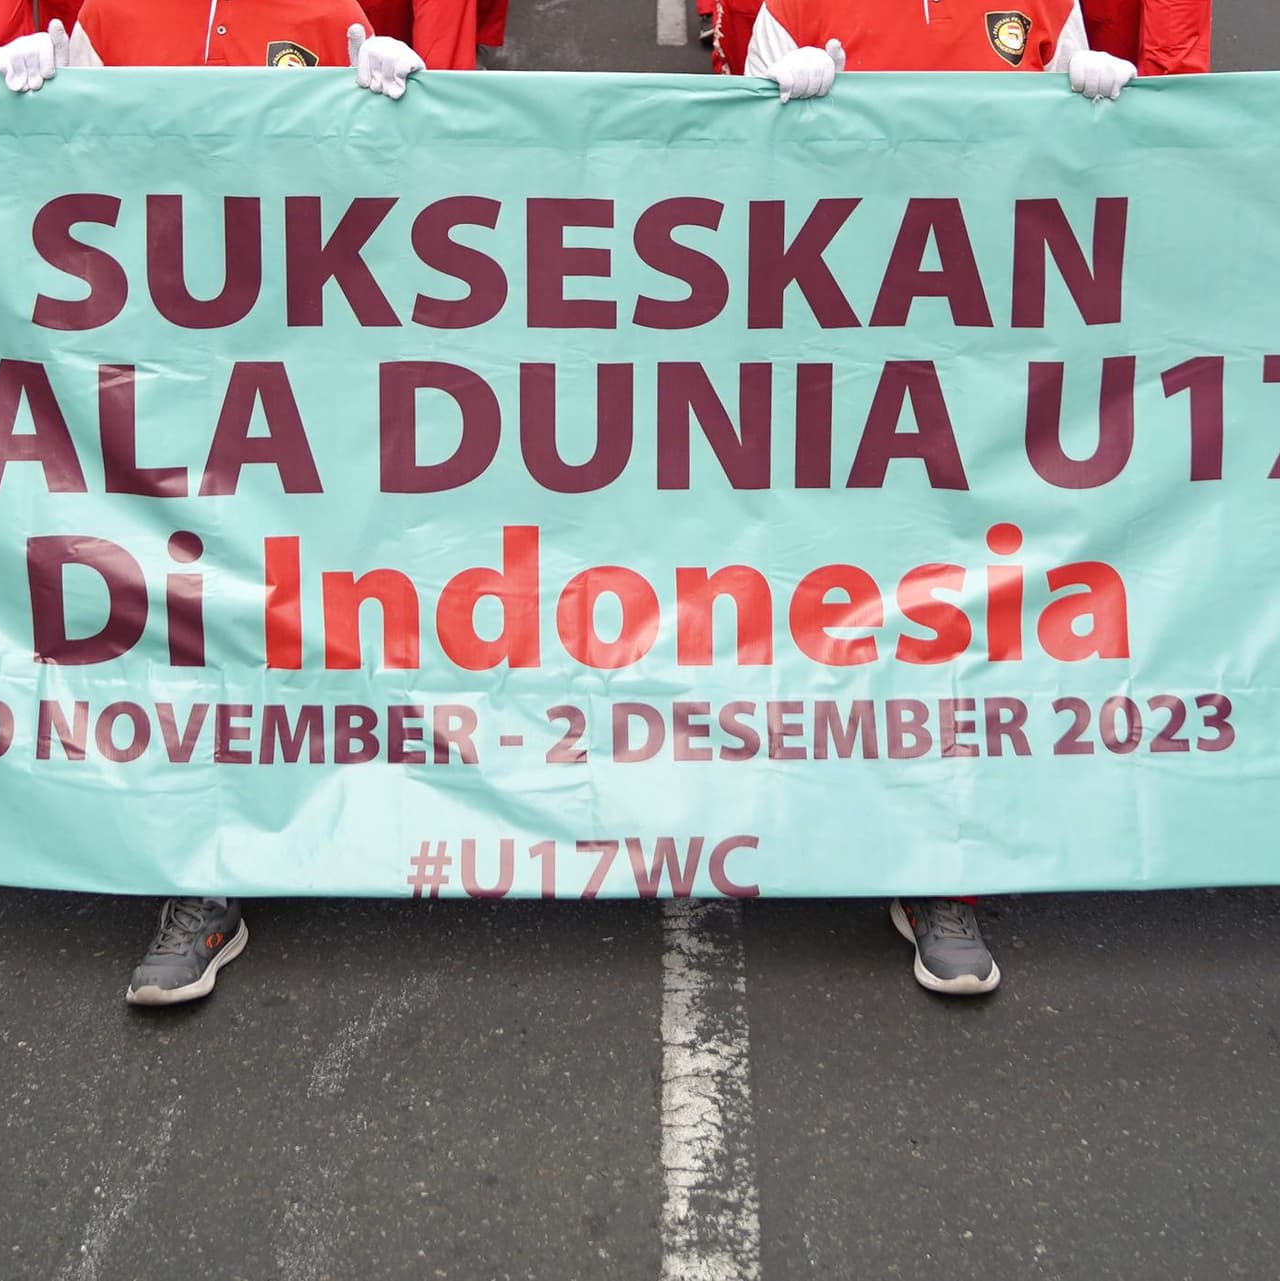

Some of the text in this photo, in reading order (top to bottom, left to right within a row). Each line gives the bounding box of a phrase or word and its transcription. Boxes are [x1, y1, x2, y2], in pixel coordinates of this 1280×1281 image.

[31, 192, 1129, 331] SUKSESKAN
[377, 360, 970, 494] DUNIA
[25, 522, 1130, 671] Di Indonesia
[36, 700, 480, 765] NOVEMBER
[545, 706, 588, 764] 2
[612, 699, 1031, 763] DESEMBER
[1053, 694, 1236, 756] 2023
[407, 835, 761, 898] #U17WC
